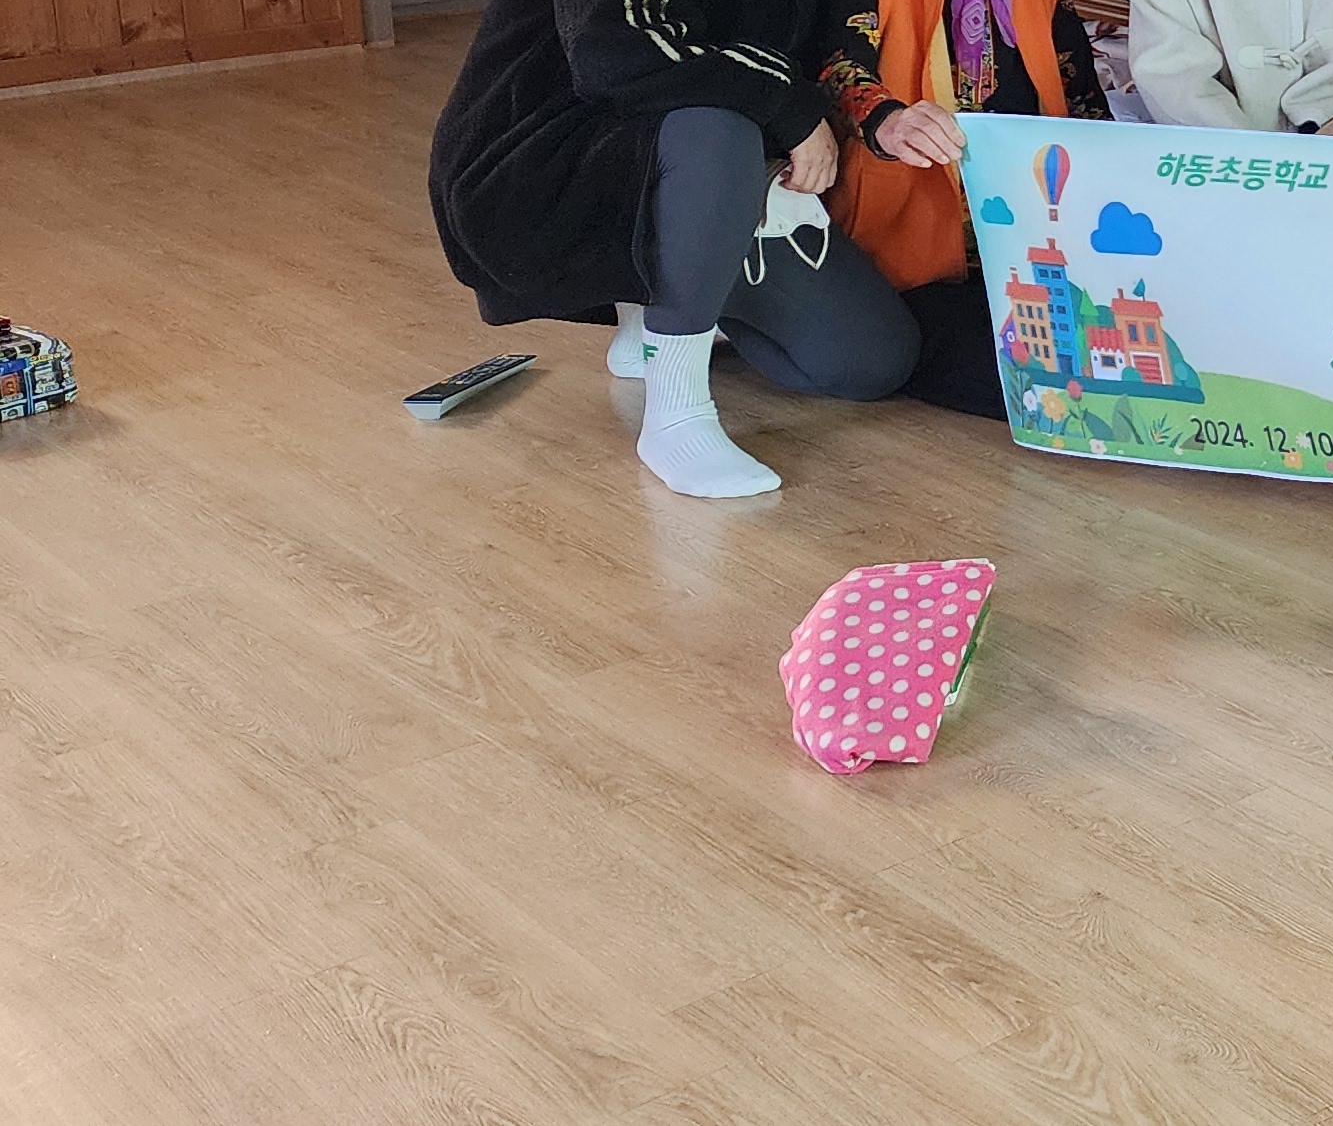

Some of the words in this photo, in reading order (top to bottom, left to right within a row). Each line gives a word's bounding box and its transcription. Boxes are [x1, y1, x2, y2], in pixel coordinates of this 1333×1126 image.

[1156, 151, 1330, 192] 하동초등학교
[1189, 417, 1255, 449] 2024.
[1262, 426, 1296, 453] 12.
